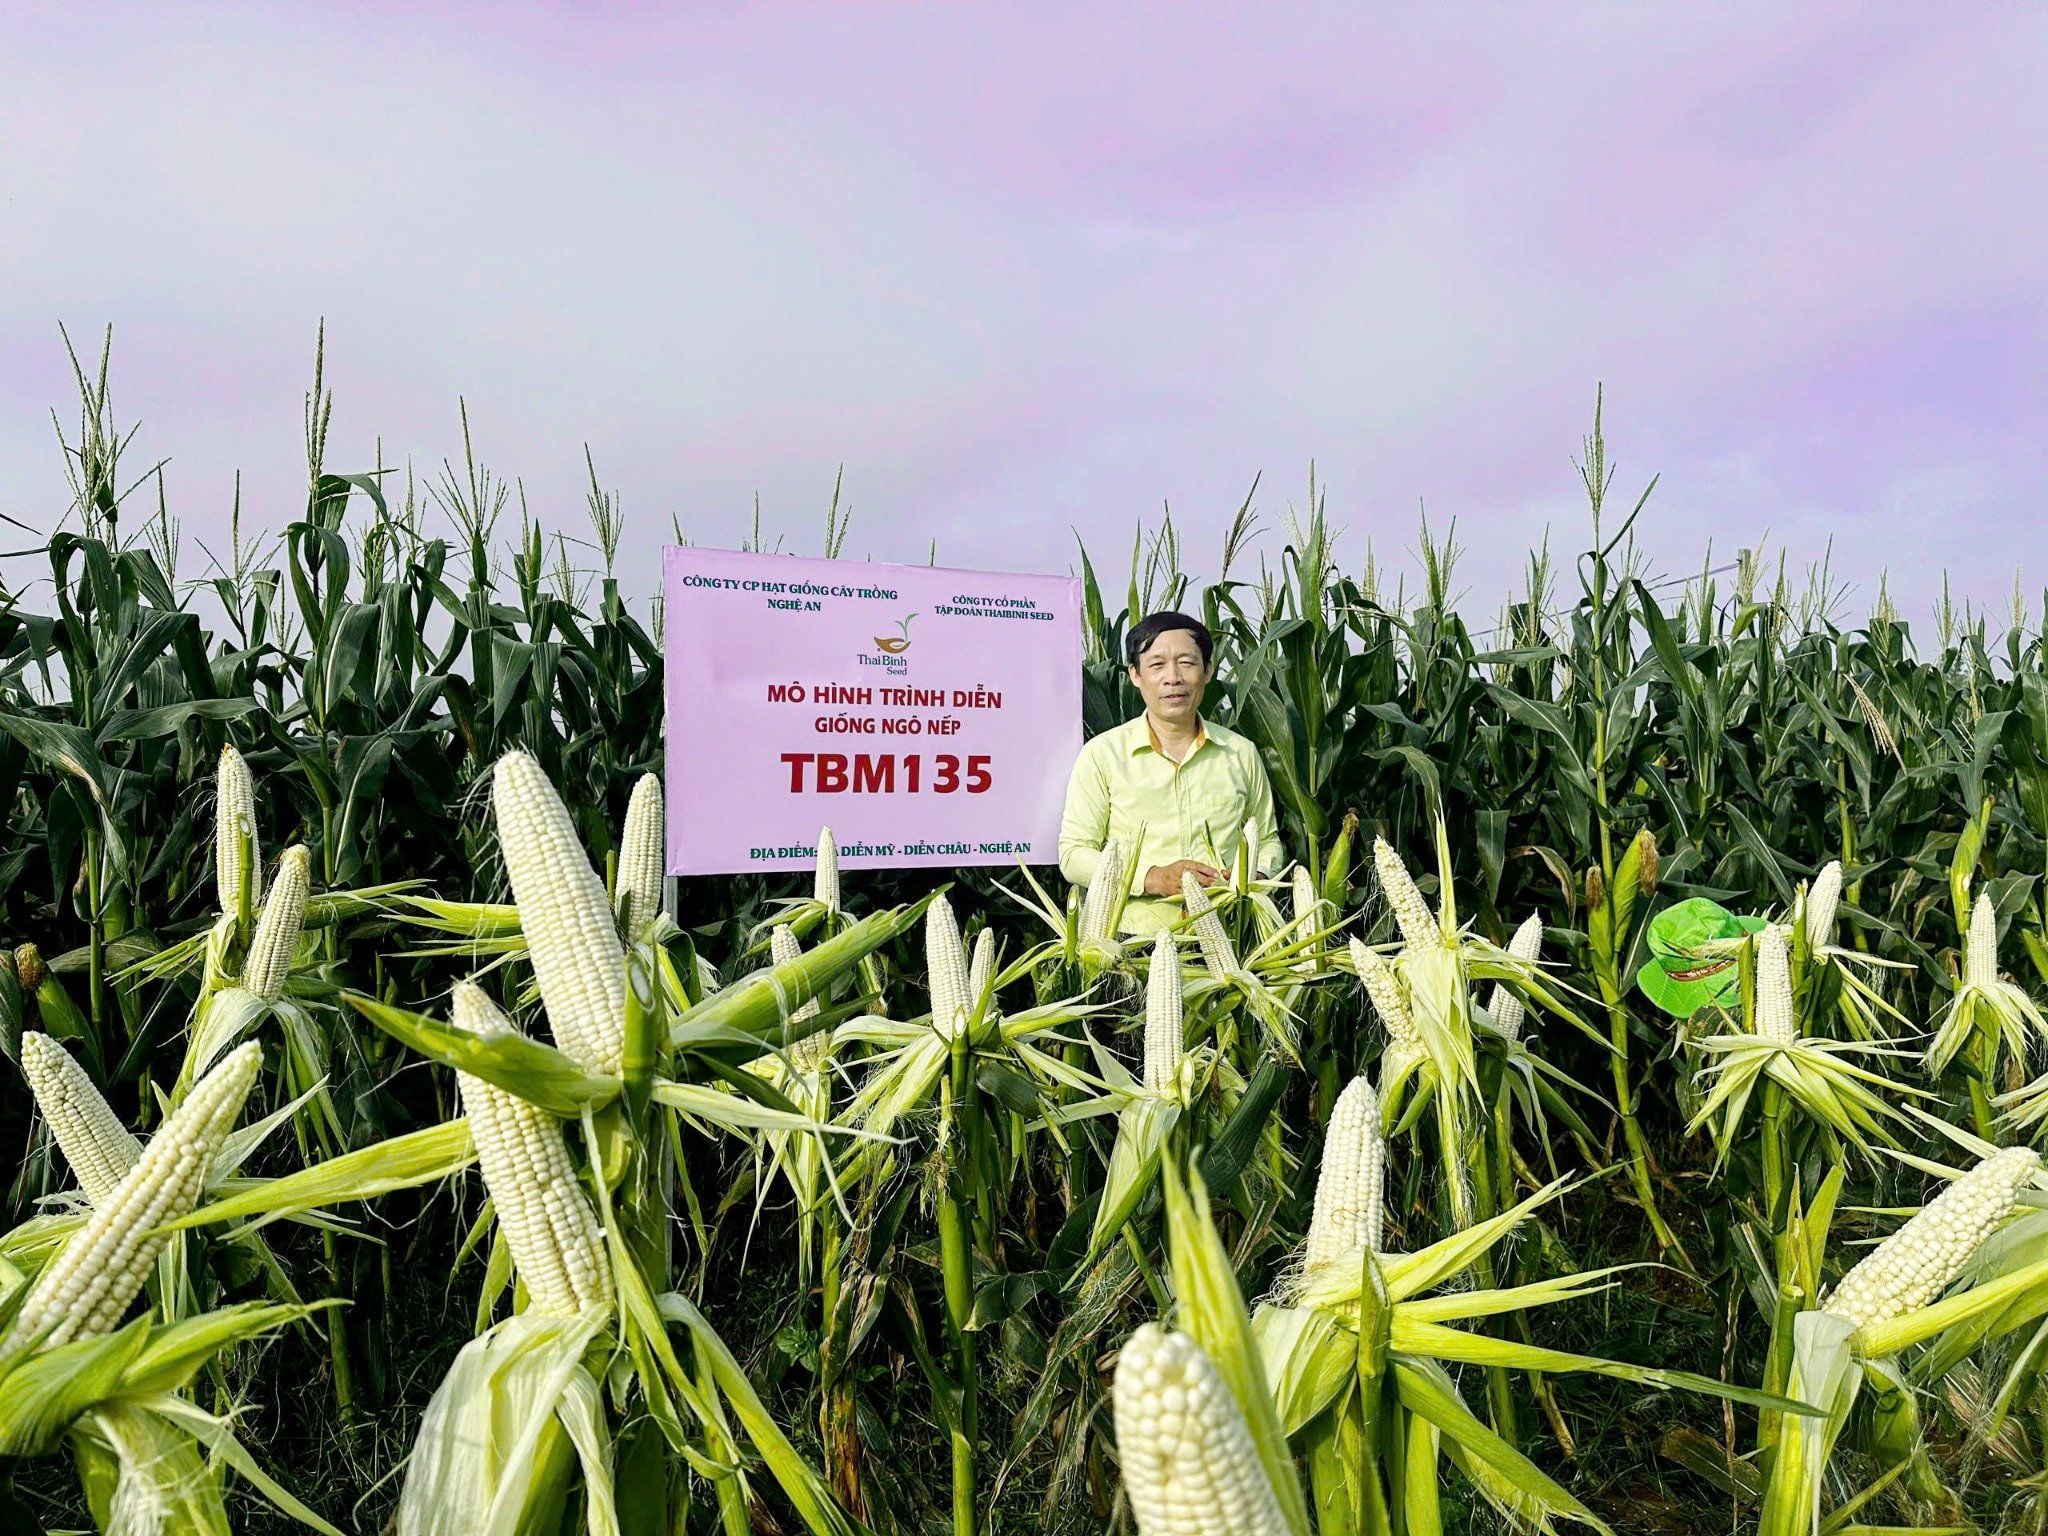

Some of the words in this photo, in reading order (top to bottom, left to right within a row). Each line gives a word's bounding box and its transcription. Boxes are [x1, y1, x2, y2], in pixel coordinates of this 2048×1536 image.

[682, 574, 722, 588] CÔNG
[723, 579, 741, 590] TY
[742, 580, 760, 591] CP
[762, 582, 787, 596] HẠT
[788, 580, 829, 596] GIỐNG
[831, 584, 856, 597] CÂY
[767, 598, 803, 612] NGHỆ
[803, 601, 822, 611] AN
[952, 595, 981, 606] CÔNG
[980, 598, 993, 606] TY
[995, 595, 1010, 607] CỔ
[935, 605, 953, 617] TẬP
[953, 605, 983, 616] ĐOÀN
[984, 608, 1029, 619] THAIBINH
[1030, 612, 1054, 620] SEED
[886, 667, 908, 675] Seed
[768, 681, 805, 702] MÔ
[814, 682, 872, 705] HÌNH
[879, 684, 945, 707] TRÌNH
[953, 683, 1002, 708] DIỄN
[815, 712, 875, 735] GIỐNG
[881, 715, 922, 735] NGÔ
[928, 714, 961, 735] NẾP
[781, 753, 992, 794] TBM135
[750, 848, 775, 861] ĐỊA
[841, 841, 873, 856] DIỄN
[876, 843, 895, 856] MỸ
[904, 840, 935, 855] DIỄN
[937, 842, 971, 855] CHÂU
[979, 840, 1013, 855] NGHỆ
[1014, 842, 1031, 853] AN
